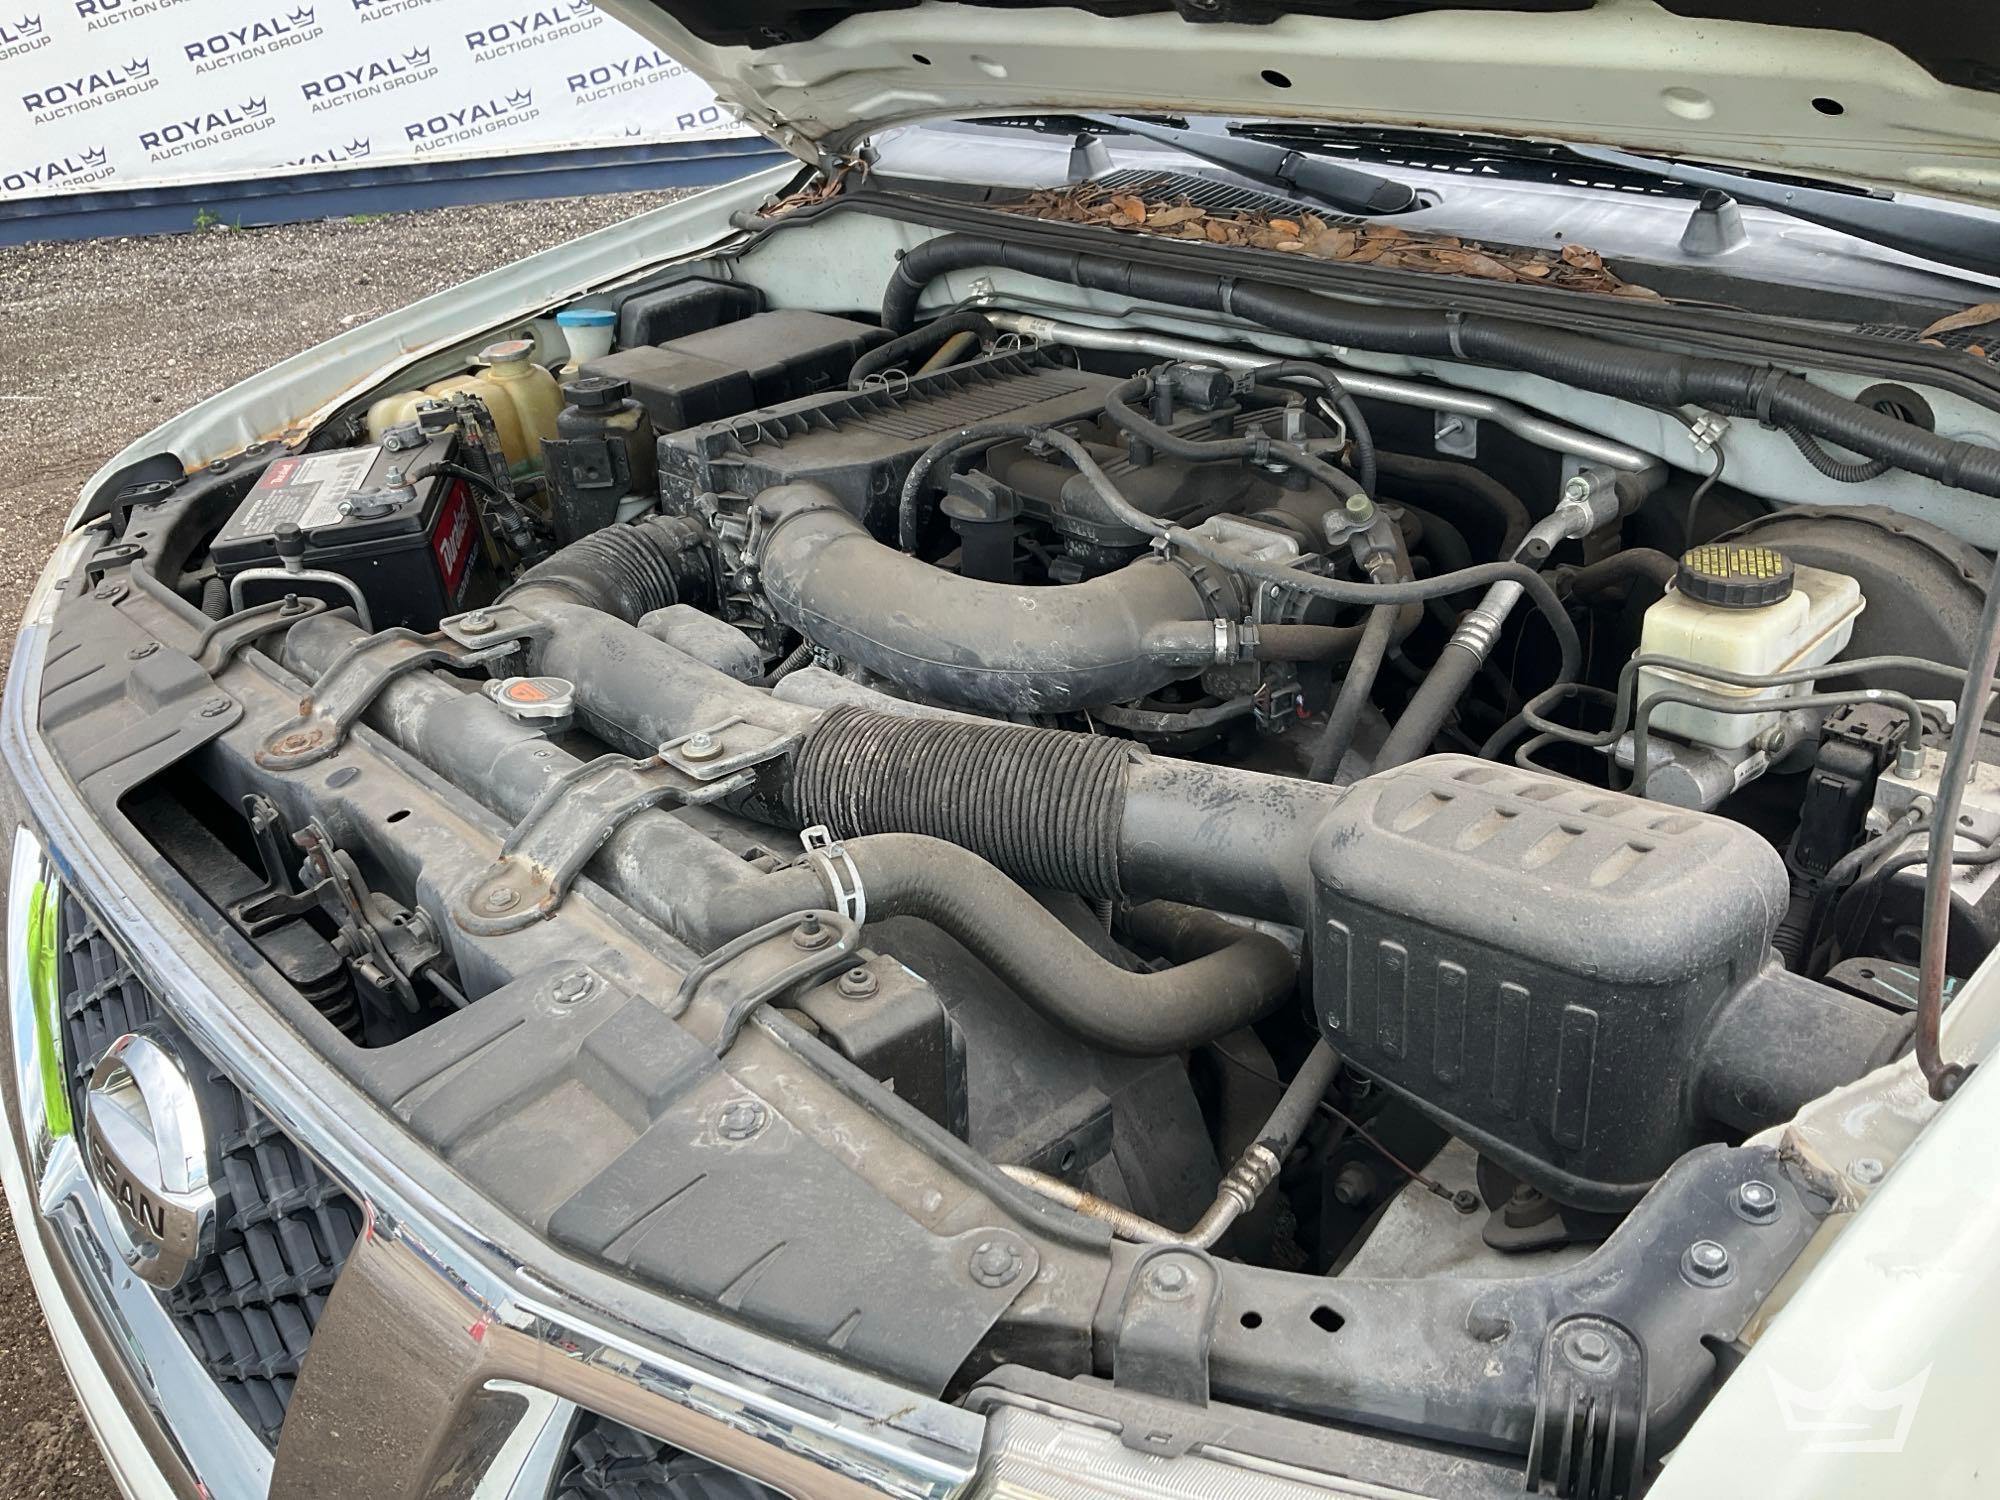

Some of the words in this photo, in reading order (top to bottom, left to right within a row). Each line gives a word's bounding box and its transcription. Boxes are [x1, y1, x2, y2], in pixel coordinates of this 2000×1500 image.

[88, 2, 157, 32] AUCTION
[465, 7, 571, 51] ROYAL
[184, 18, 291, 62] ROYAL
[195, 45, 266, 75] AUCTION
[268, 27, 324, 52] GROUP
[474, 34, 545, 64] AUCTION
[547, 16, 604, 41] GROUP
[22, 69, 126, 112] ROYAL
[301, 57, 406, 100] ROYAL
[312, 84, 381, 114] AUCTION
[383, 67, 439, 91] GROUP
[567, 50, 671, 93] ROYAL
[575, 76, 645, 106] AUCTION
[647, 66, 689, 83] GRO
[34, 95, 103, 125] AUCTION
[105, 78, 159, 103] GROUP
[404, 99, 508, 141] ROYAL
[138, 108, 243, 150] ROYAL
[151, 134, 219, 163] AUCTION
[221, 117, 276, 141] GROUP
[414, 125, 483, 154] AUCTION
[485, 108, 540, 132] GROUP
[0, 158, 84, 192] OYAL
